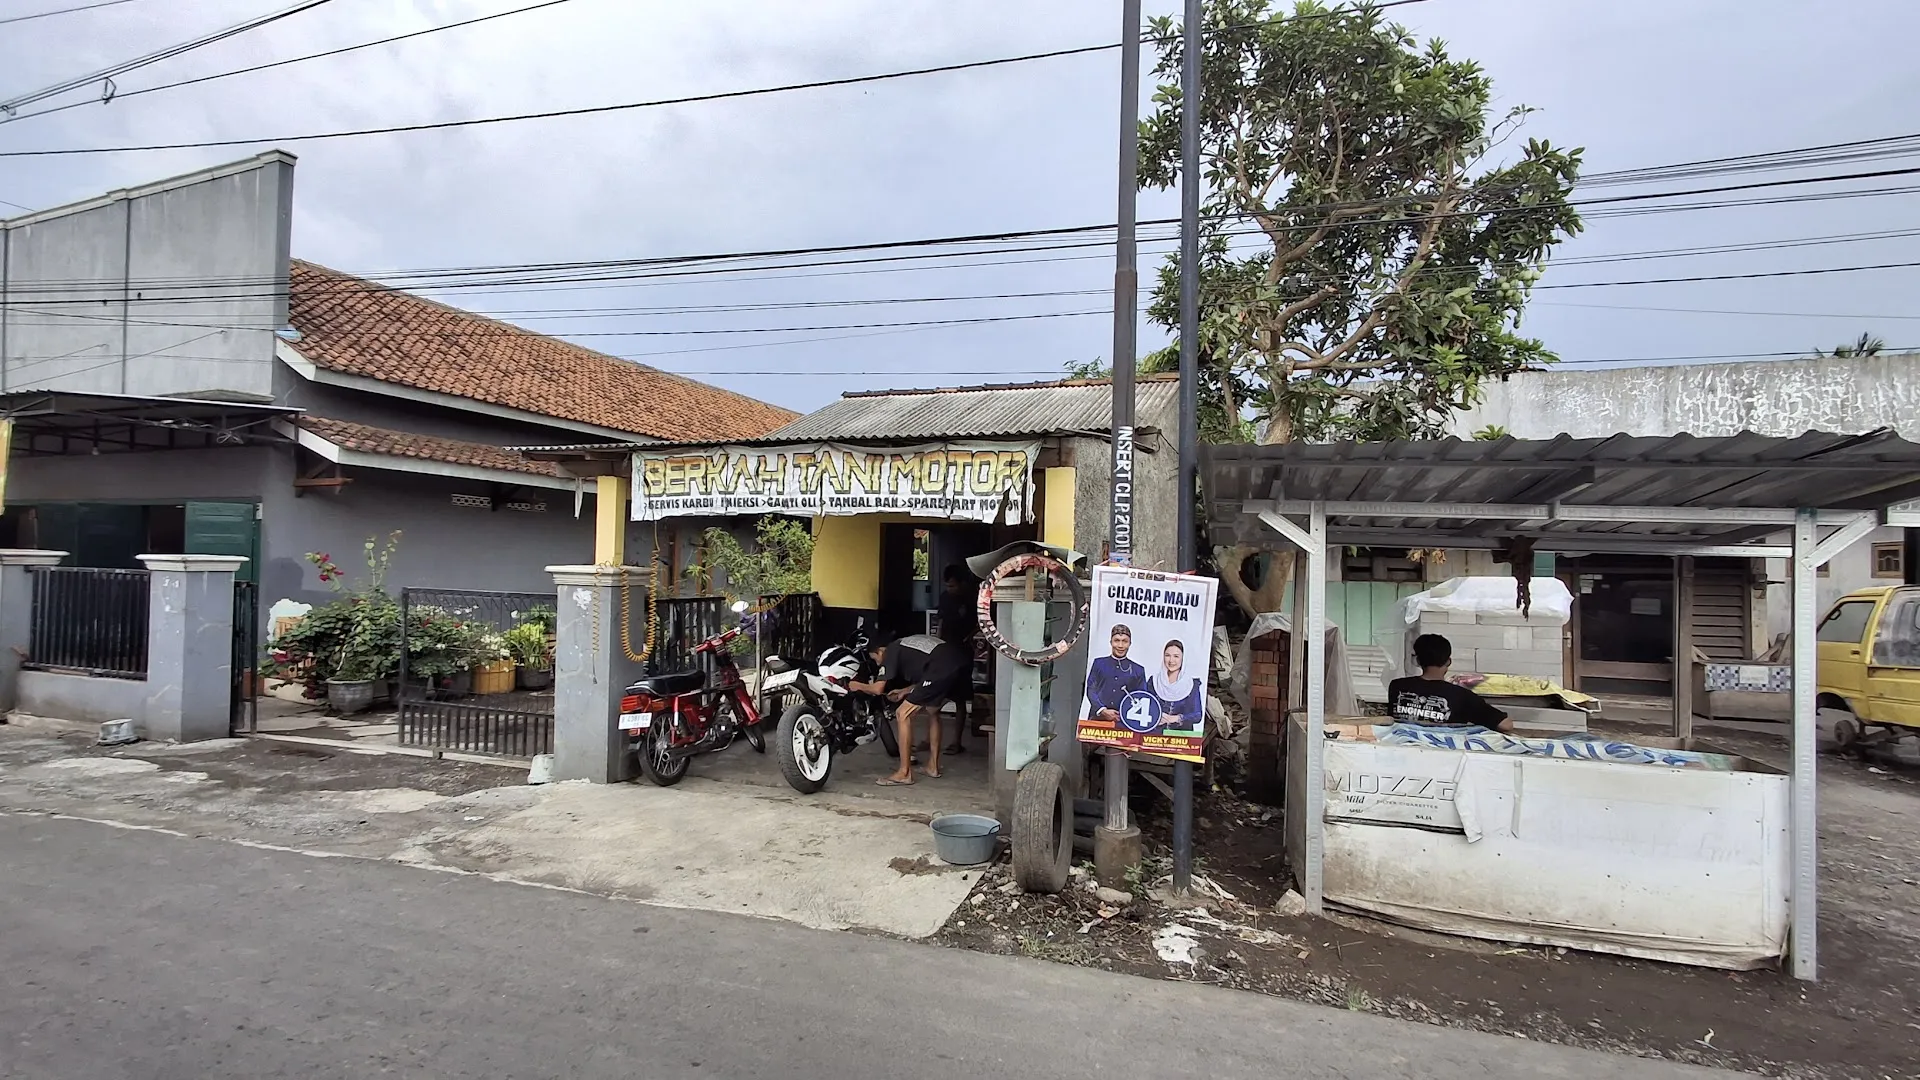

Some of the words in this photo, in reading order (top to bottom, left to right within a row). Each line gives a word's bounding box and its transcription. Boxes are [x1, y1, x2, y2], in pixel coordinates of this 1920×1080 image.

[1114, 426, 1133, 481] INSERT
[643, 453, 787, 497] BERKAH
[792, 450, 884, 496] TANI
[888, 450, 1028, 496] MOTOR
[648, 499, 680, 510] SERVIS
[801, 497, 817, 508] OLI
[828, 496, 873, 508] TAMBAL
[875, 496, 899, 508] BAN
[1107, 584, 1162, 603] CILACAP
[1163, 590, 1200, 608] MAJU
[1115, 599, 1189, 622] BERCAHAYA
[1126, 697, 1153, 728] 4
[1396, 705, 1446, 721] ENGINEER
[1080, 727, 1134, 740] AWALUDDIN
[1142, 735, 1169, 744] VICKY
[1170, 737, 1189, 746] SHU
[1344, 794, 1366, 805] Mild
